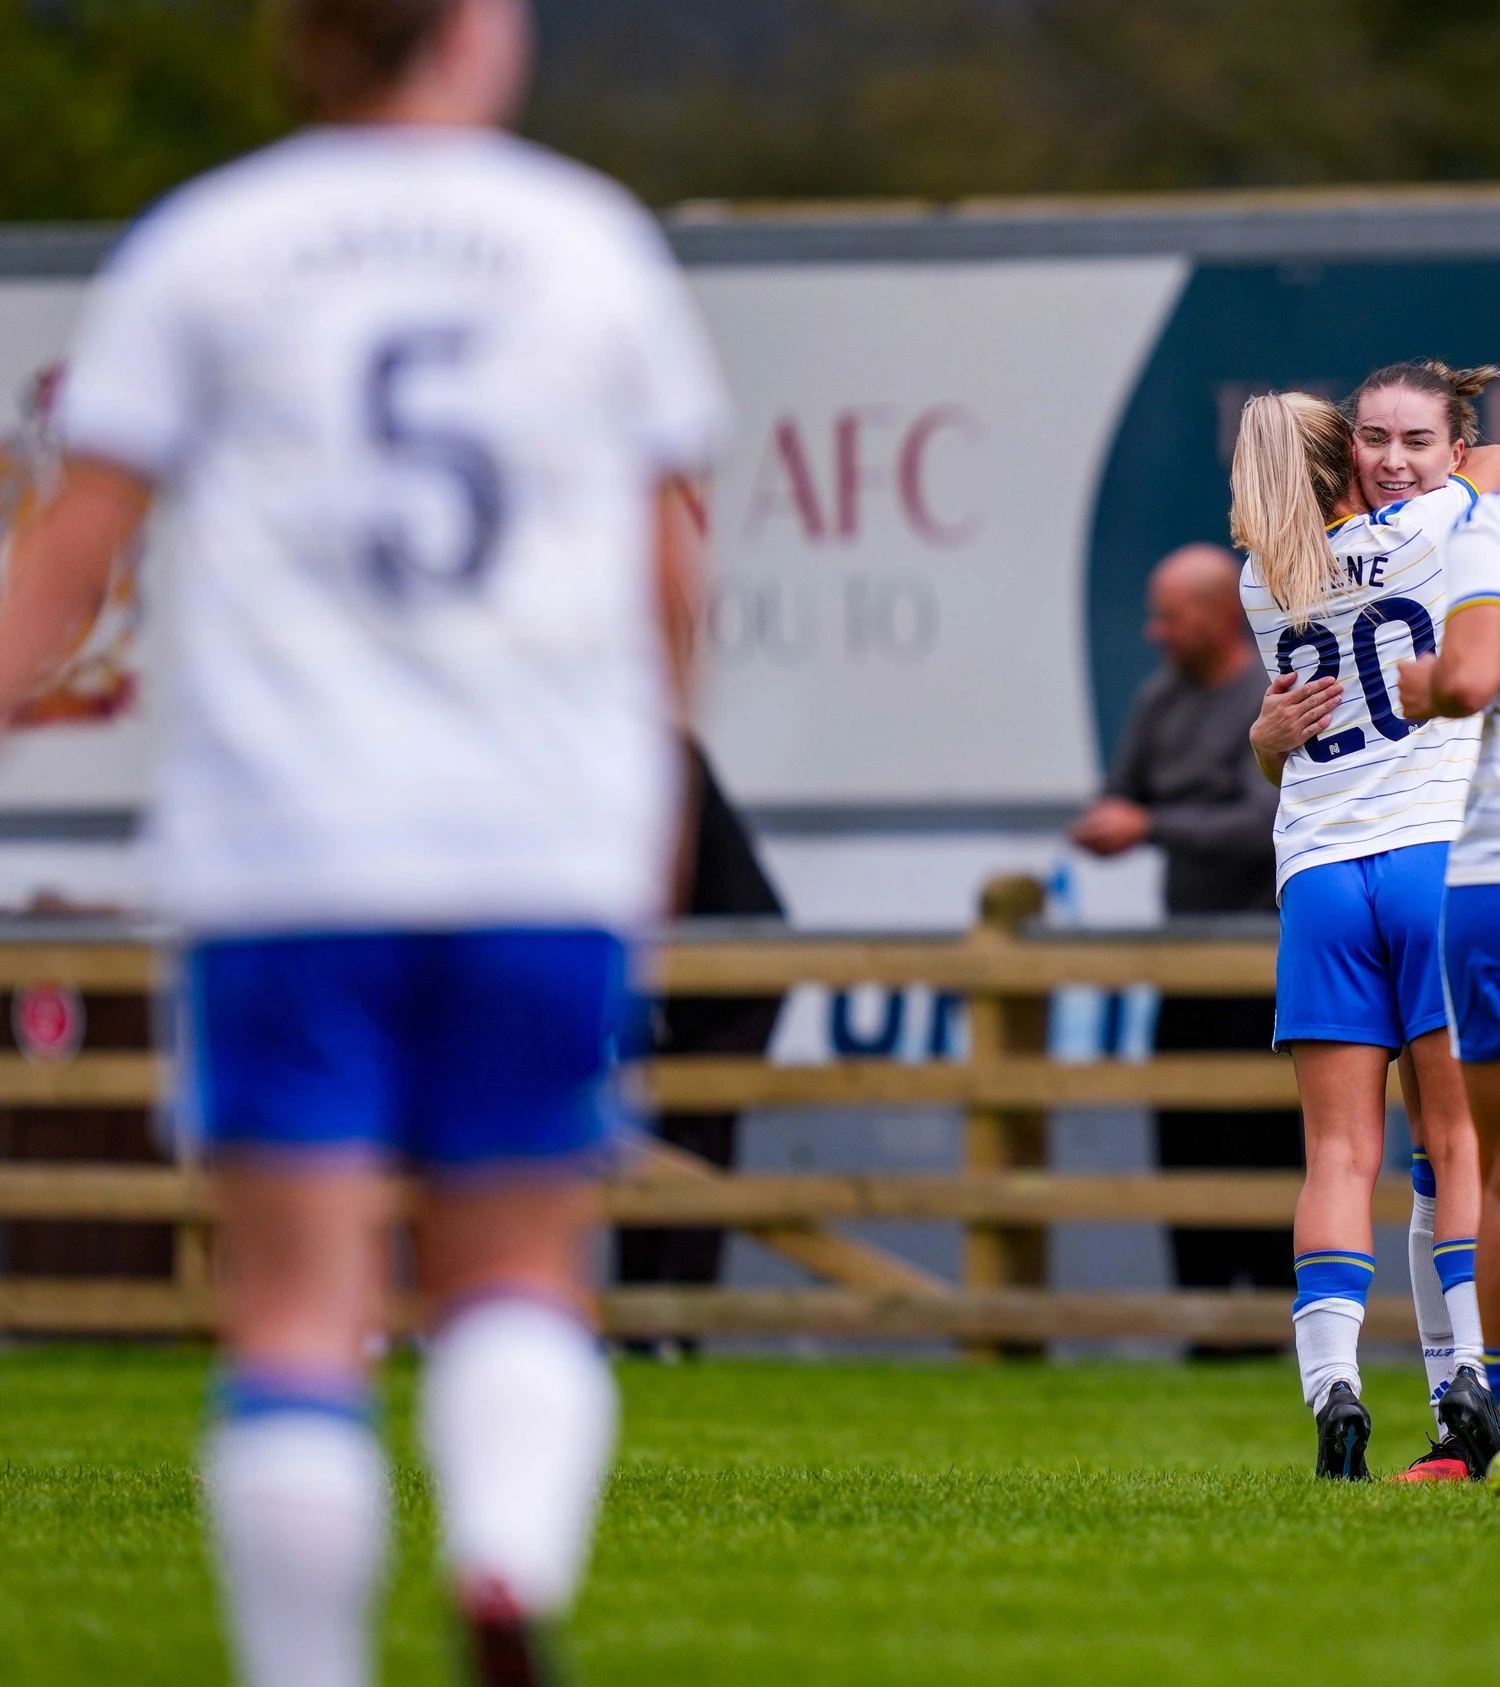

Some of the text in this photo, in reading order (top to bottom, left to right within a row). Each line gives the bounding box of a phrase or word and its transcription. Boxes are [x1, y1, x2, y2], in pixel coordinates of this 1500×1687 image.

[362, 320, 506, 604] 5
[745, 402, 988, 551] AFC
[1276, 596, 1438, 763] 20
